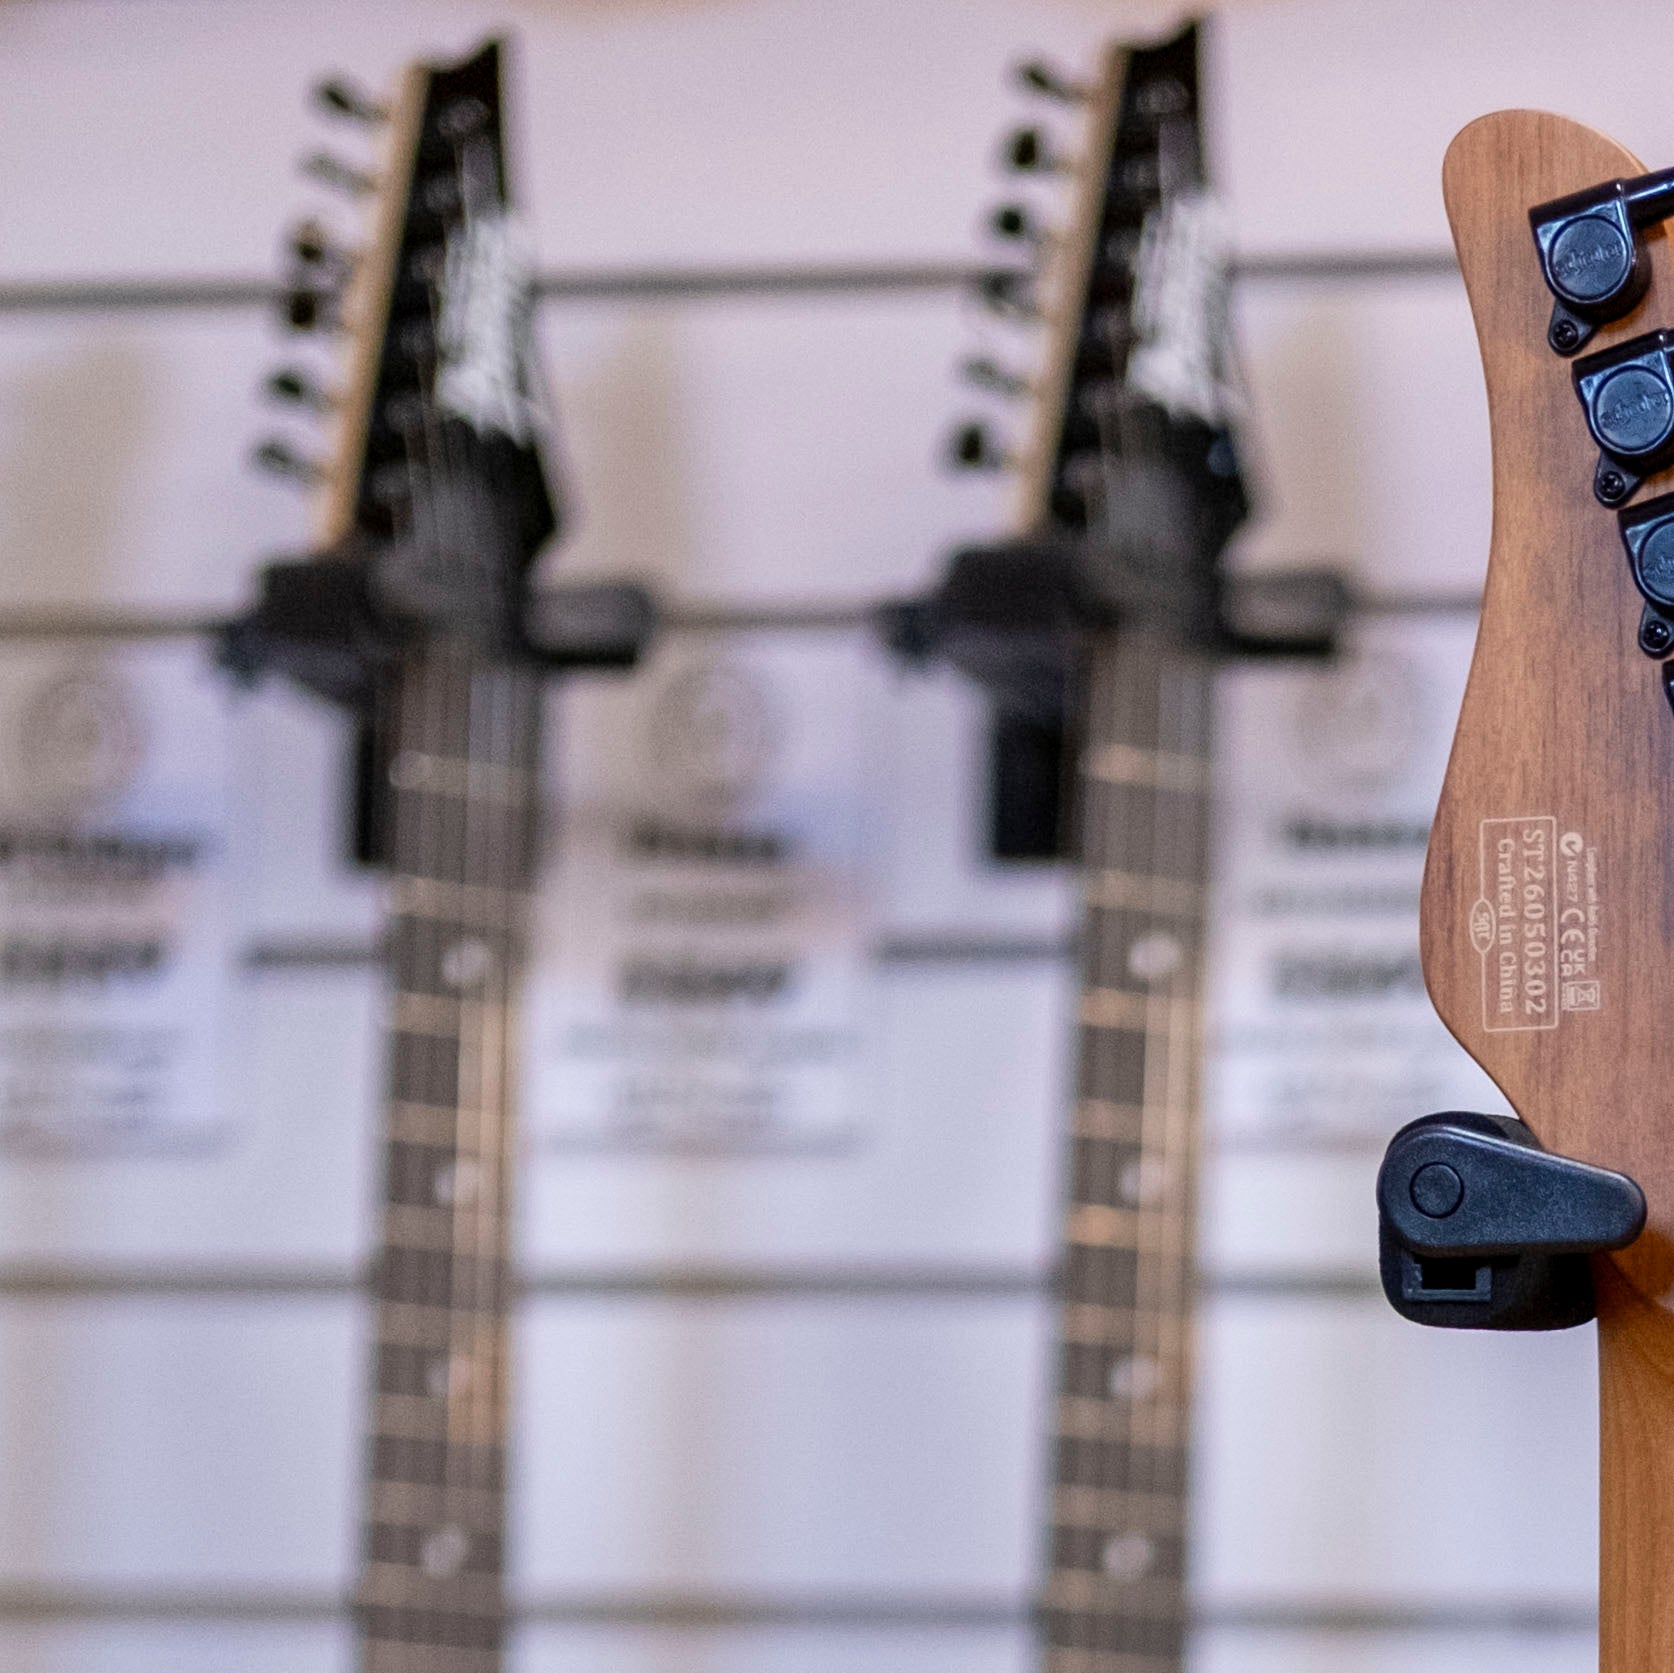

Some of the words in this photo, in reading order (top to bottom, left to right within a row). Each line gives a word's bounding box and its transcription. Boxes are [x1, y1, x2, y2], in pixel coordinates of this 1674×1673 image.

[1498, 838, 1517, 918] Crafted
[1499, 924, 1517, 945] in
[1523, 829, 1546, 1015] ST26050302
[1499, 951, 1517, 1013] China
